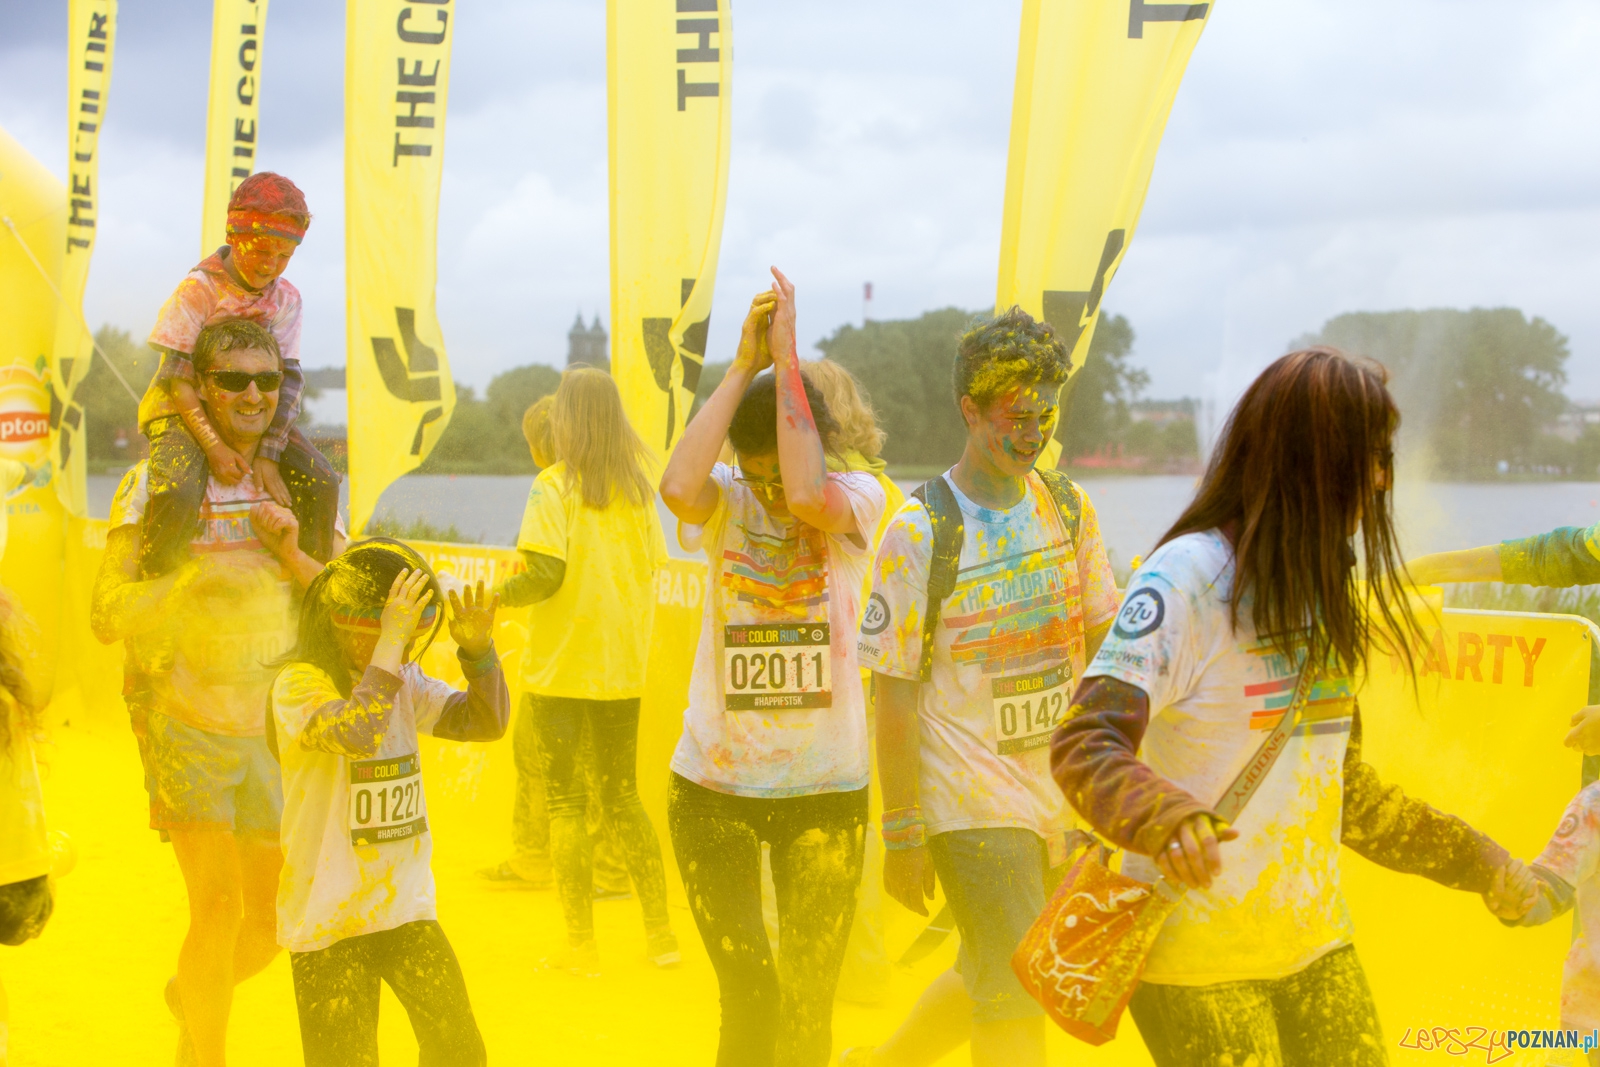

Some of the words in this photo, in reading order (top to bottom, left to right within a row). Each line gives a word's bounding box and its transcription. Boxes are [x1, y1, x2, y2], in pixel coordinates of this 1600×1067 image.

[397, 0, 449, 45] C
[238, 0, 258, 106] COL
[393, 57, 441, 168] THE
[184, 406, 219, 450] HAPPY
[991, 571, 1044, 606] COLOR
[1123, 601, 1153, 624] PZU
[731, 630, 748, 644] THE
[748, 630, 779, 643] COLOR
[779, 629, 799, 643] RUN
[857, 640, 880, 657] OWIE
[731, 652, 823, 690] 02011
[999, 681, 1015, 694] THE
[1015, 676, 1044, 692] COLOR
[1043, 672, 1059, 687] RUN
[754, 695, 803, 707] #HAPPIEST5K
[1000, 686, 1071, 737] 01421
[1024, 733, 1052, 748] #HAPPIES
[357, 766, 373, 780] THE
[374, 763, 400, 779] COLOR
[399, 761, 412, 775] RUN
[1232, 731, 1286, 811] SNOOPY
[355, 779, 420, 825] 01227
[377, 825, 413, 840] #HAPPIEST5K
